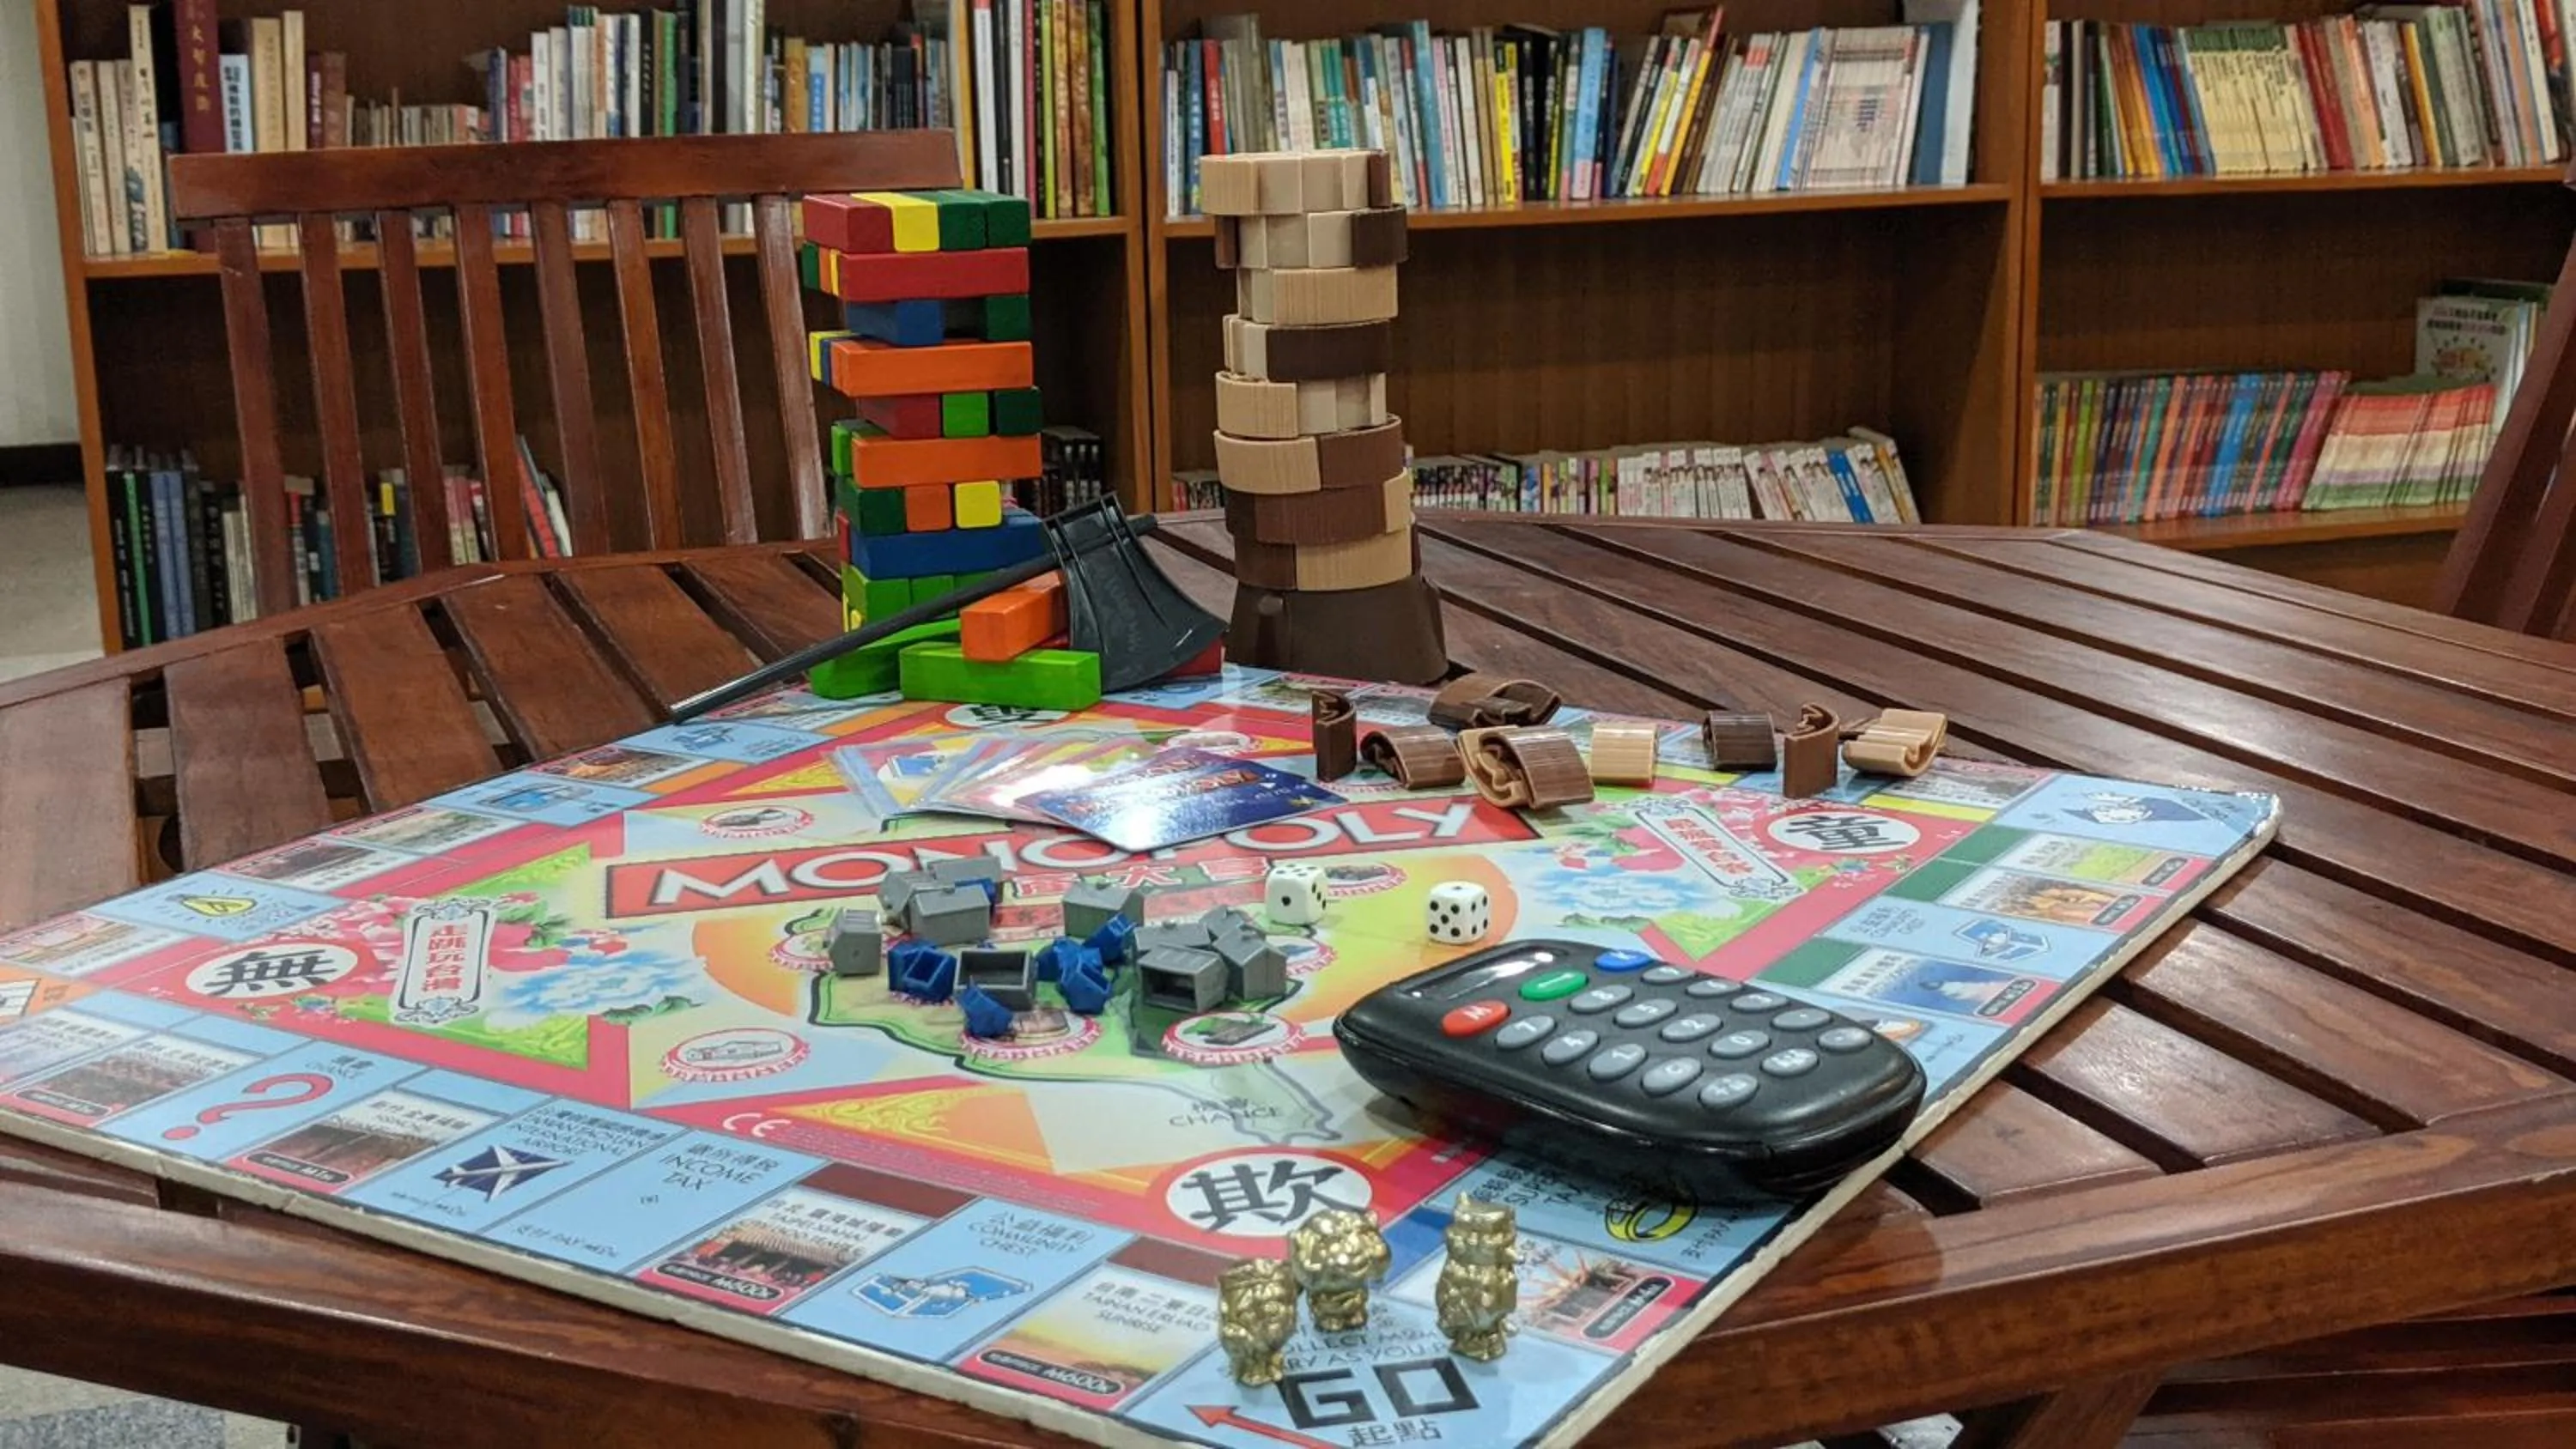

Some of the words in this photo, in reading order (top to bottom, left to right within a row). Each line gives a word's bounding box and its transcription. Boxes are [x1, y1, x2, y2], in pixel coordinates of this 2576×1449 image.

[652, 801, 1476, 906] MONOOLY
[203, 949, 338, 997] 無
[1513, 1020, 1538, 1033] 7
[1680, 1019, 1705, 1030] 2
[1561, 1036, 1584, 1047] 4
[721, 1113, 792, 1138] CE
[653, 1152, 767, 1185] INCOME
[654, 1171, 717, 1191] TAX
[1181, 1160, 1366, 1233] 欺
[1091, 1309, 1167, 1335] SUNRISE
[1368, 1345, 1425, 1360] YOU
[1273, 1355, 1482, 1430] GO
[1346, 1416, 1443, 1449] 起點
